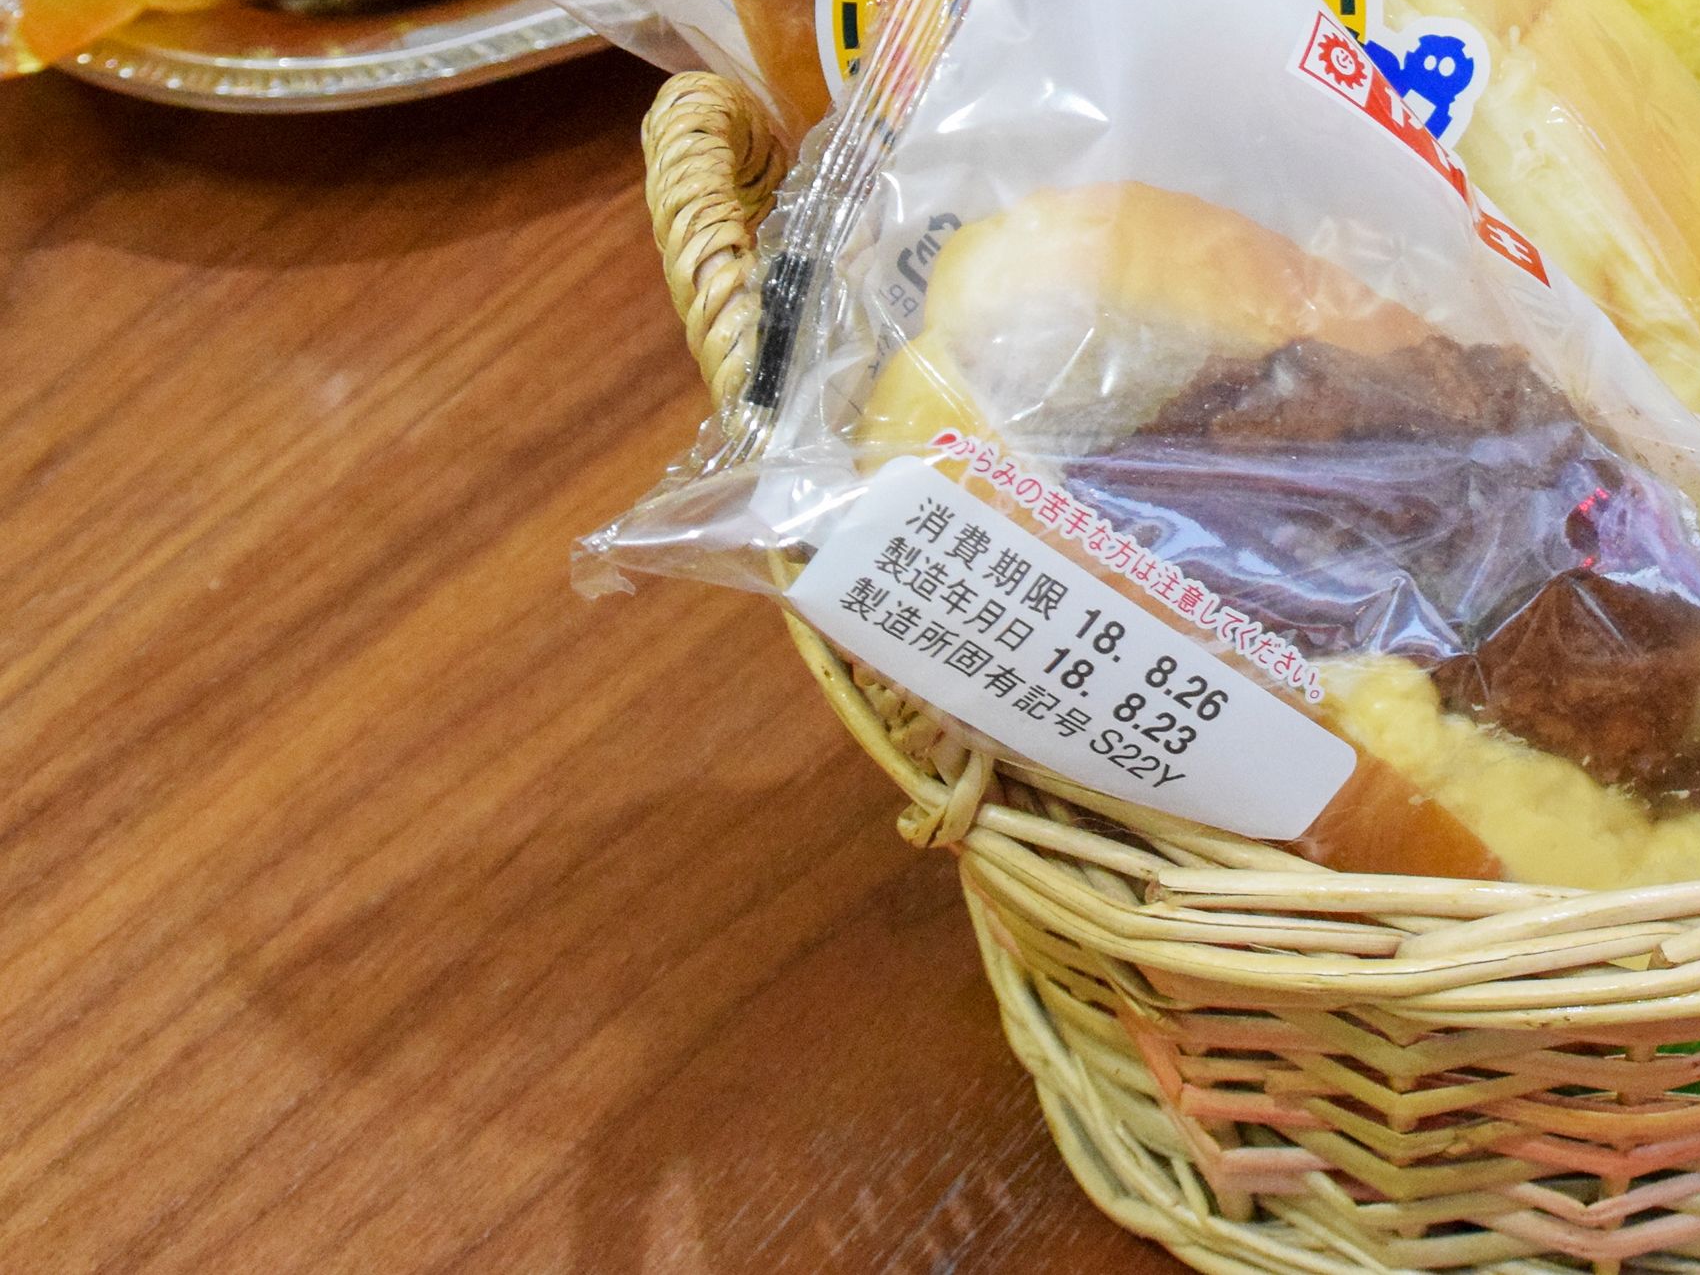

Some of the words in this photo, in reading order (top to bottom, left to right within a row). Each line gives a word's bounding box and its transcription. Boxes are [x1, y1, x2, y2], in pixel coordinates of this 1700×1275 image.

[872, 535, 1036, 654] 製造年月日
[1042, 645, 1097, 699] 18.
[1111, 690, 1199, 756] 8.23
[904, 495, 1071, 623] 消費期限
[1072, 605, 1127, 665] 18.
[1144, 654, 1230, 724] 8.26
[953, 433, 1326, 703] からみの苦手な方は注意してください。
[837, 575, 1094, 741] 製造所固有記号
[1089, 726, 1188, 791] S22Y
